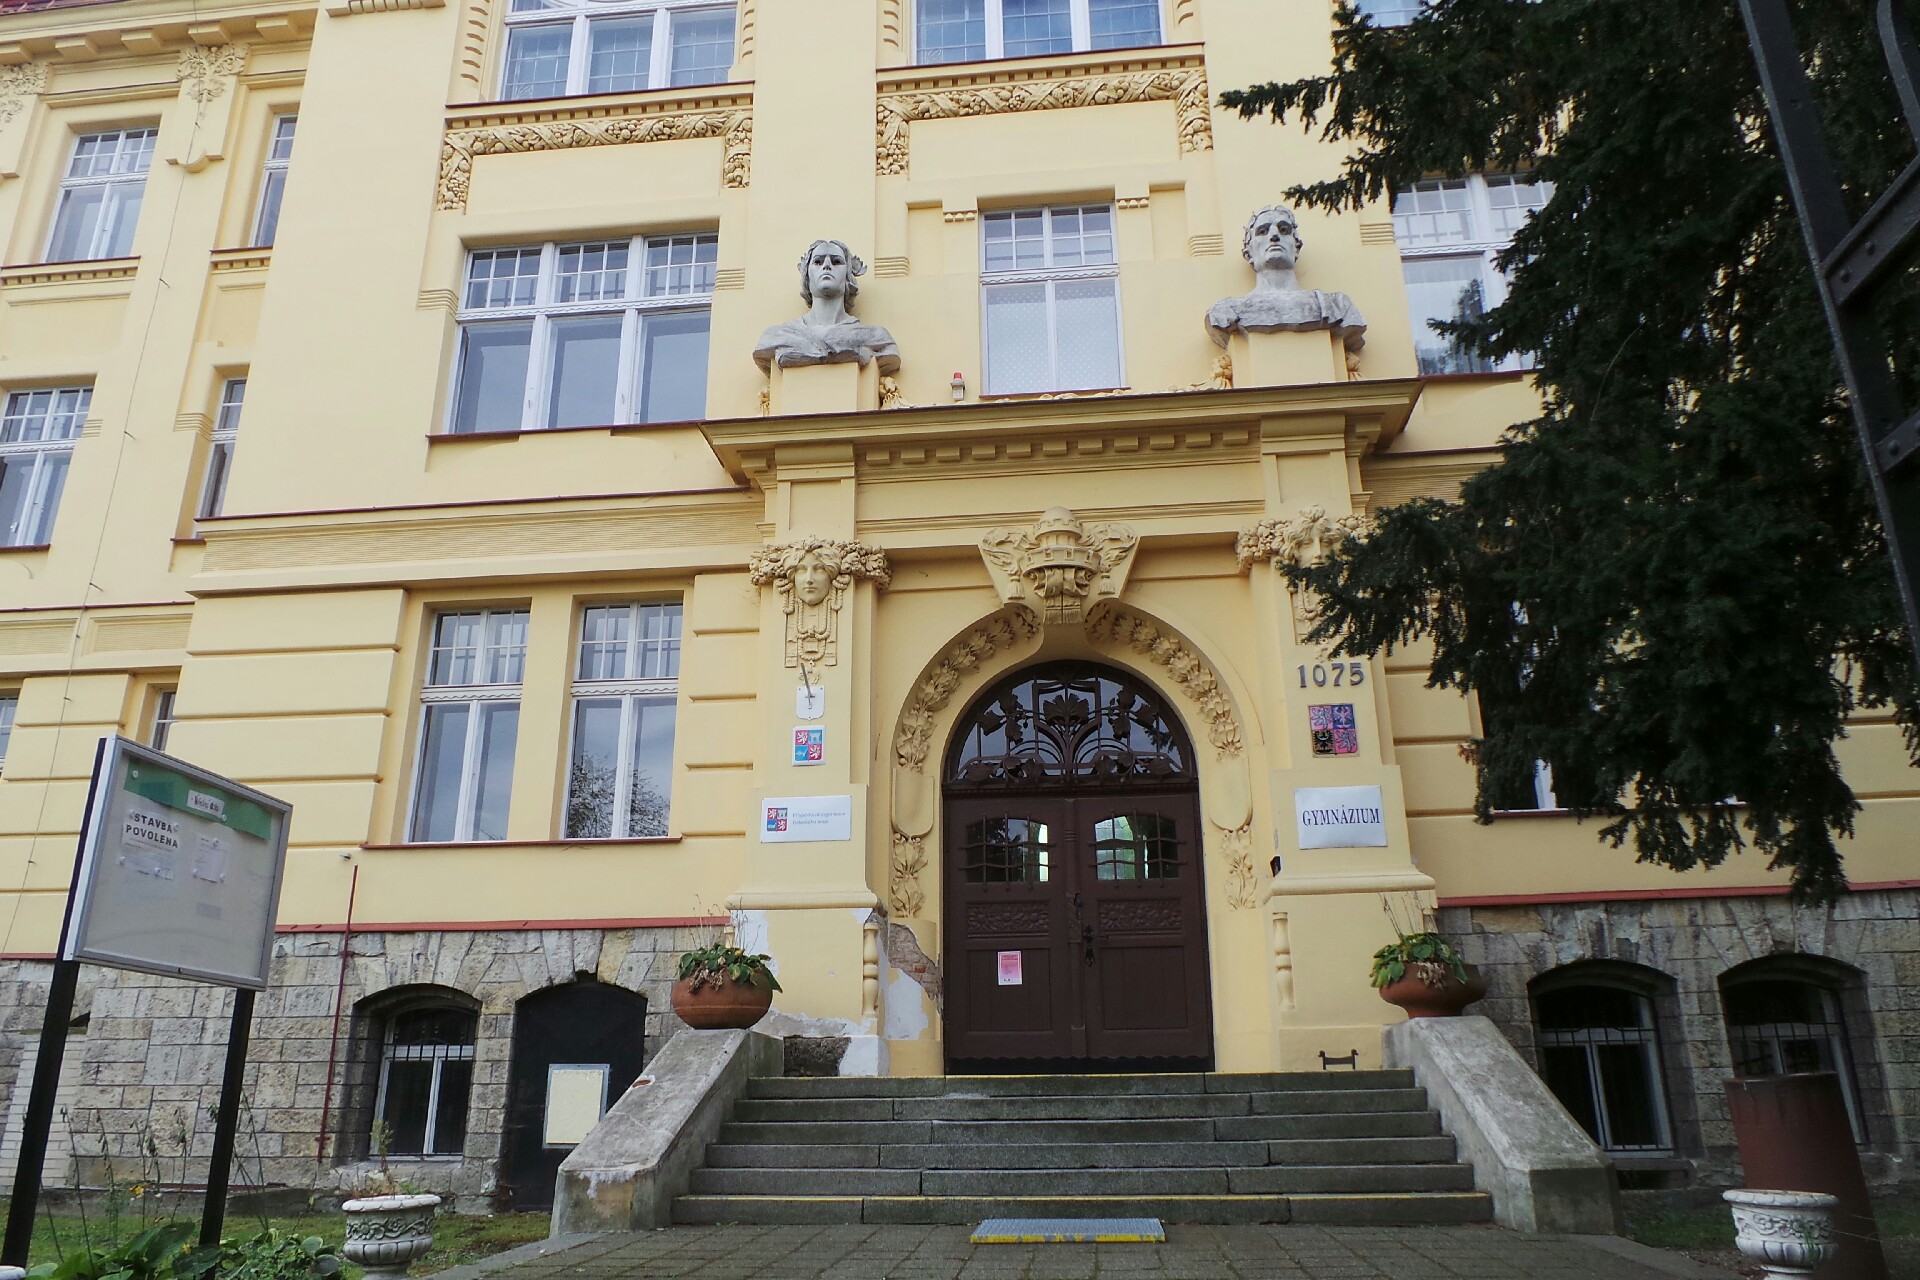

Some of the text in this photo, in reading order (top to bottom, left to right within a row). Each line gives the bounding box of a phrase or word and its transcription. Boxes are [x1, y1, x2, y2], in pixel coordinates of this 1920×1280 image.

[1297, 662, 1365, 688] 1075
[134, 813, 173, 833] STAVBA
[1302, 804, 1380, 827] GYMNÁZIUM
[126, 824, 178, 848] POVOLENA
